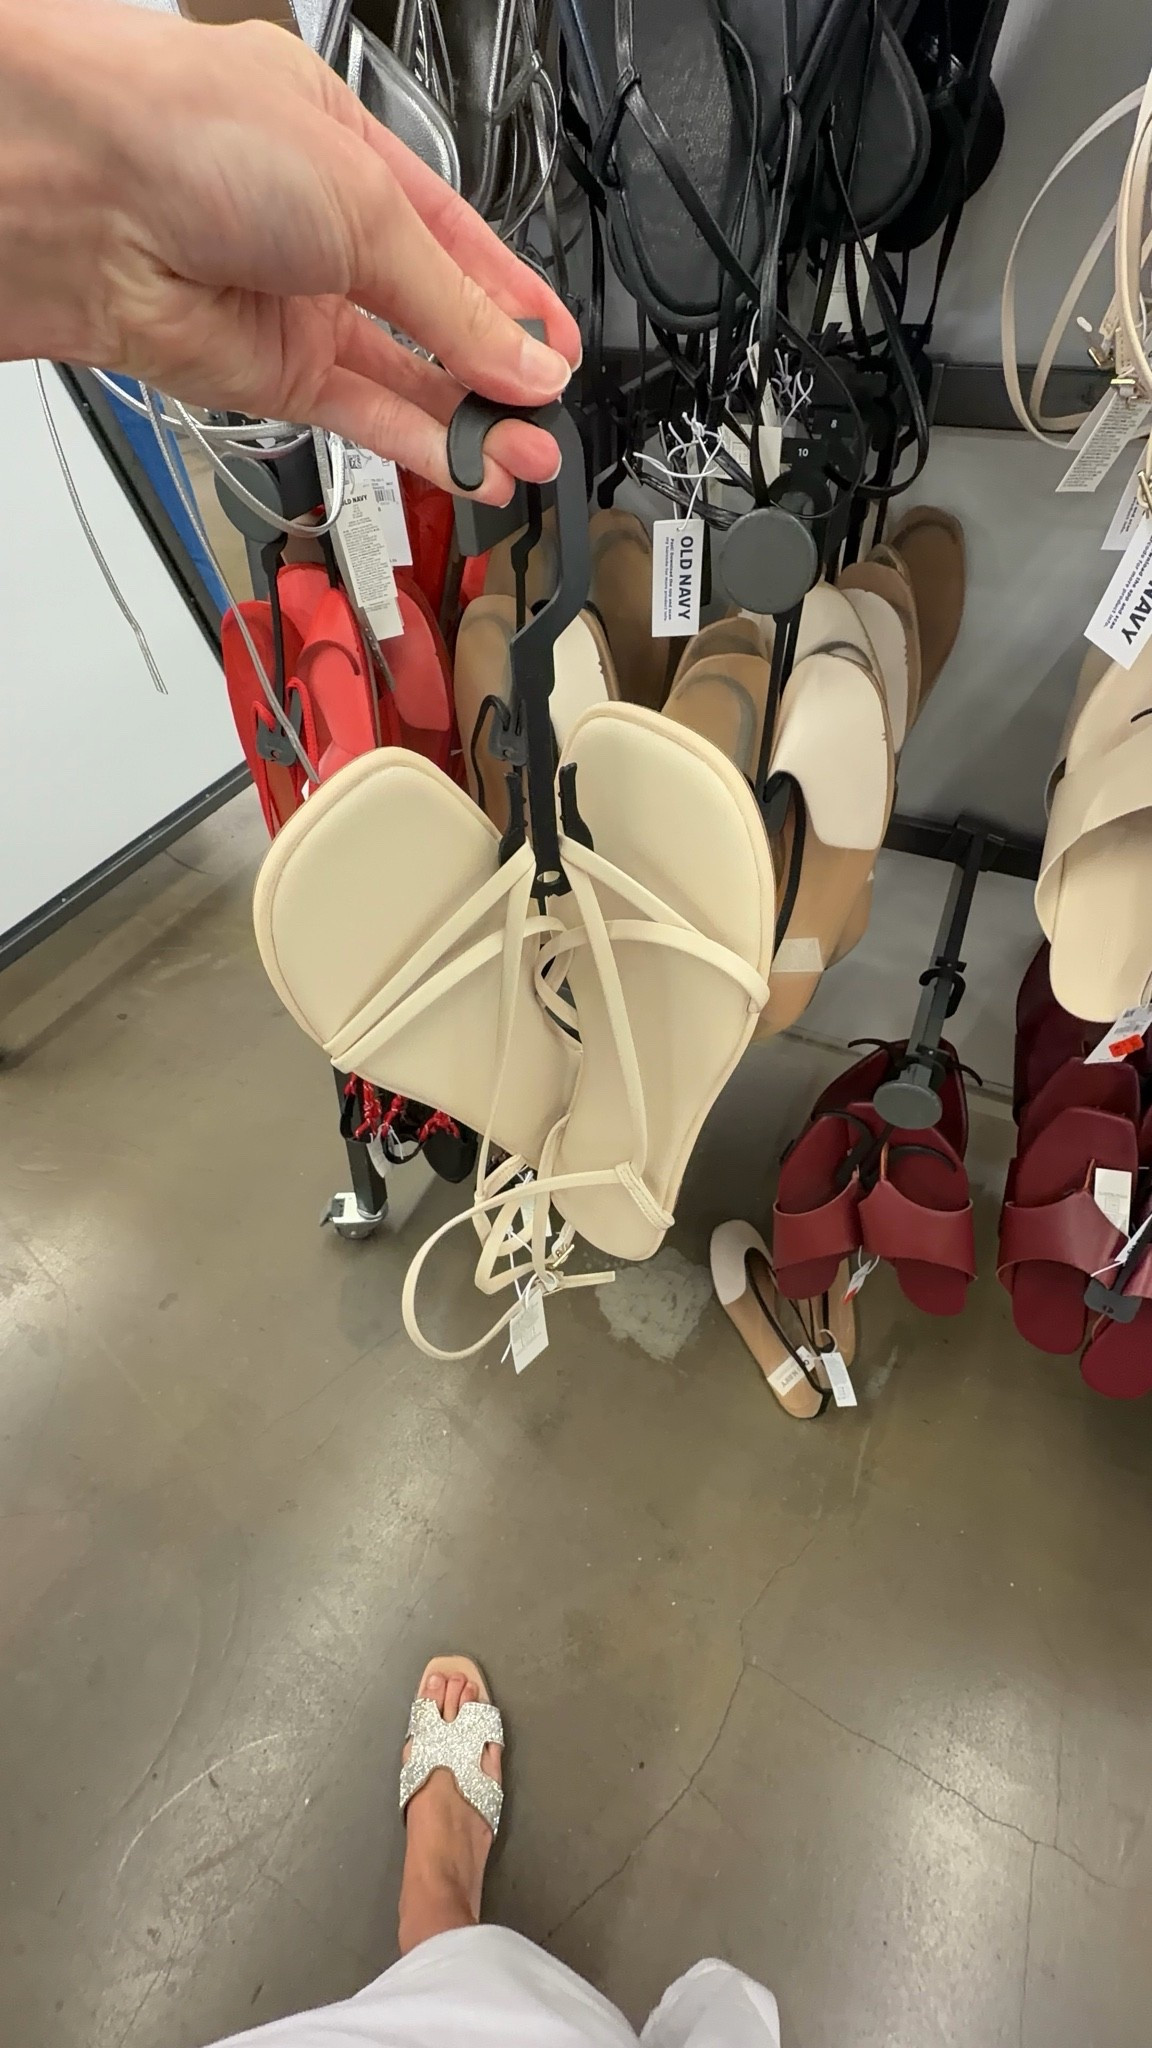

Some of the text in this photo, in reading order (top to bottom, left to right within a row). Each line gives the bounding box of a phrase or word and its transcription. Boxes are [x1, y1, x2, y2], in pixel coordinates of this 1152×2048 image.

[830, 419, 838, 429] 8
[797, 448, 809, 457] 10
[353, 495, 367, 503] NAVY
[1135, 560, 1143, 570] for
[678, 536, 693, 620] OLD NAVY
[1125, 571, 1136, 588] more
[1132, 577, 1141, 588] the
[1111, 588, 1127, 613] product
[1125, 589, 1133, 601] app
[1118, 602, 1126, 615] and
[1103, 614, 1113, 628] info.
[1109, 615, 1119, 629] scan
